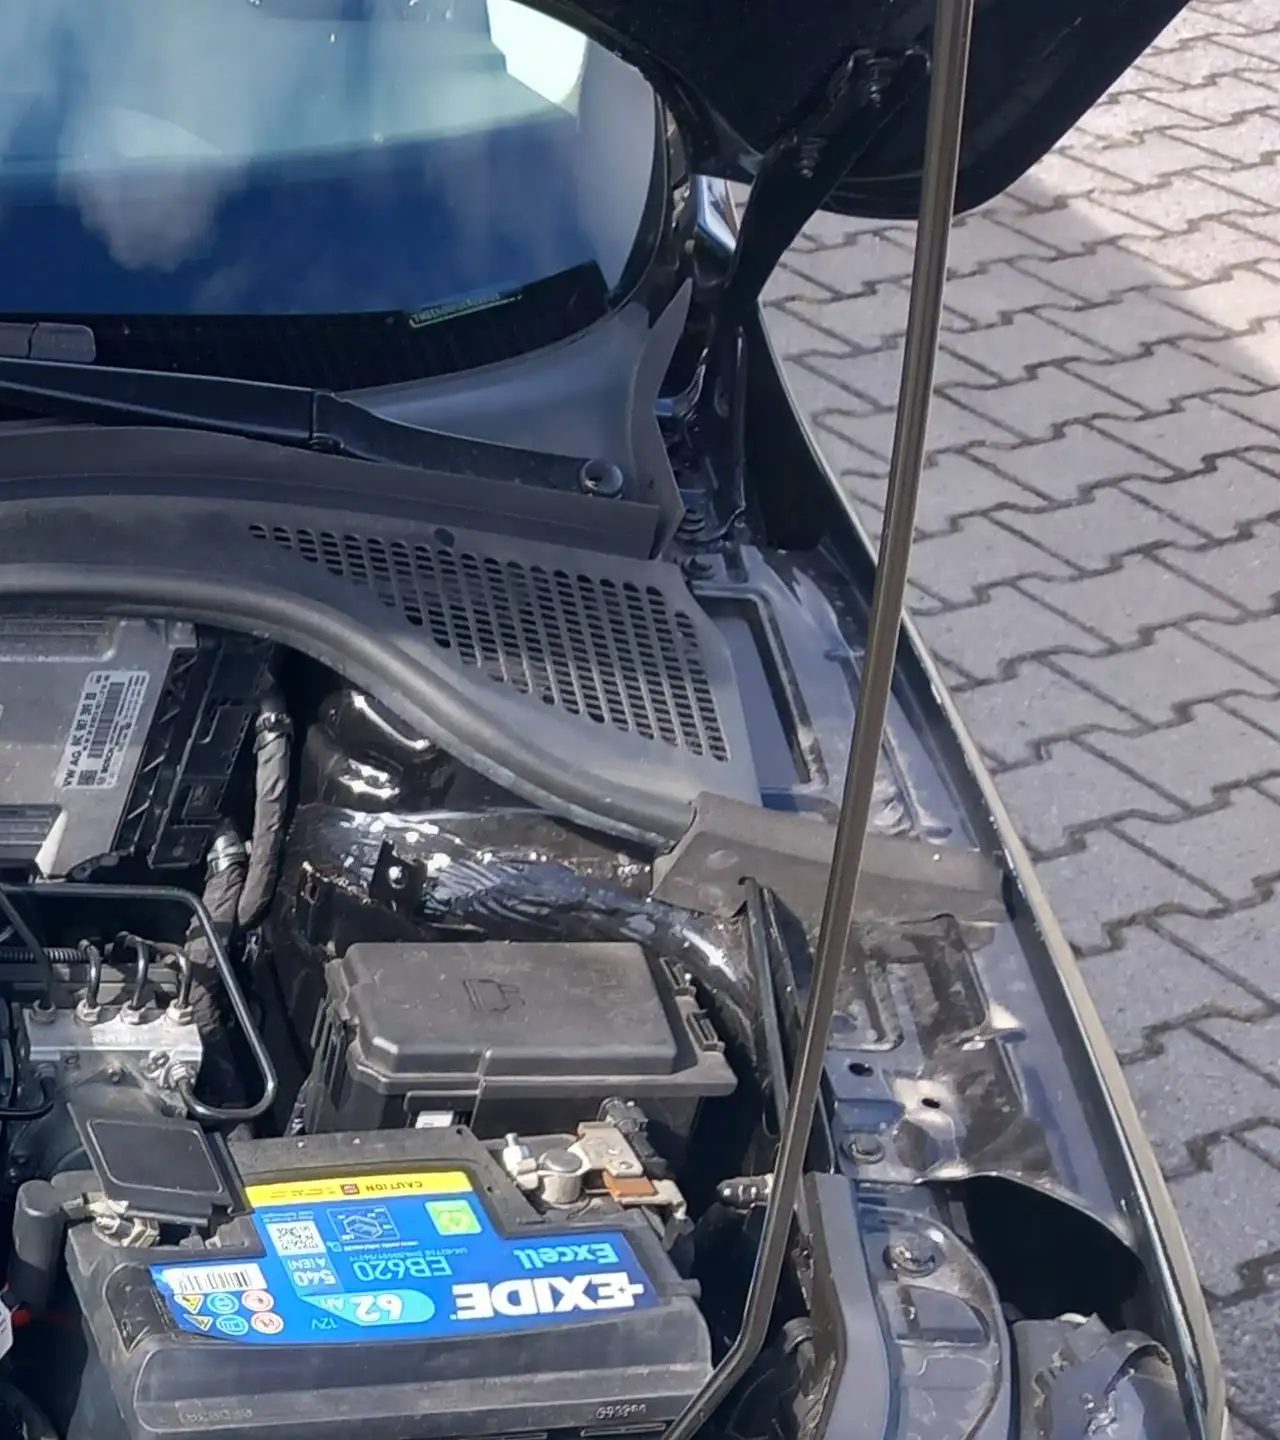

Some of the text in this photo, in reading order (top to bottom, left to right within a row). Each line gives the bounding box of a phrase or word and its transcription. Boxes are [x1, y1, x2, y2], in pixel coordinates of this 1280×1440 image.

[365, 1179, 423, 1192] CAUTION
[353, 1255, 453, 1283] EB620
[513, 1242, 619, 1270] Excell
[293, 1267, 337, 1286] 540
[354, 1293, 403, 1325] 62
[452, 1272, 644, 1320] EXIDE
[310, 1317, 337, 1331] 12V
